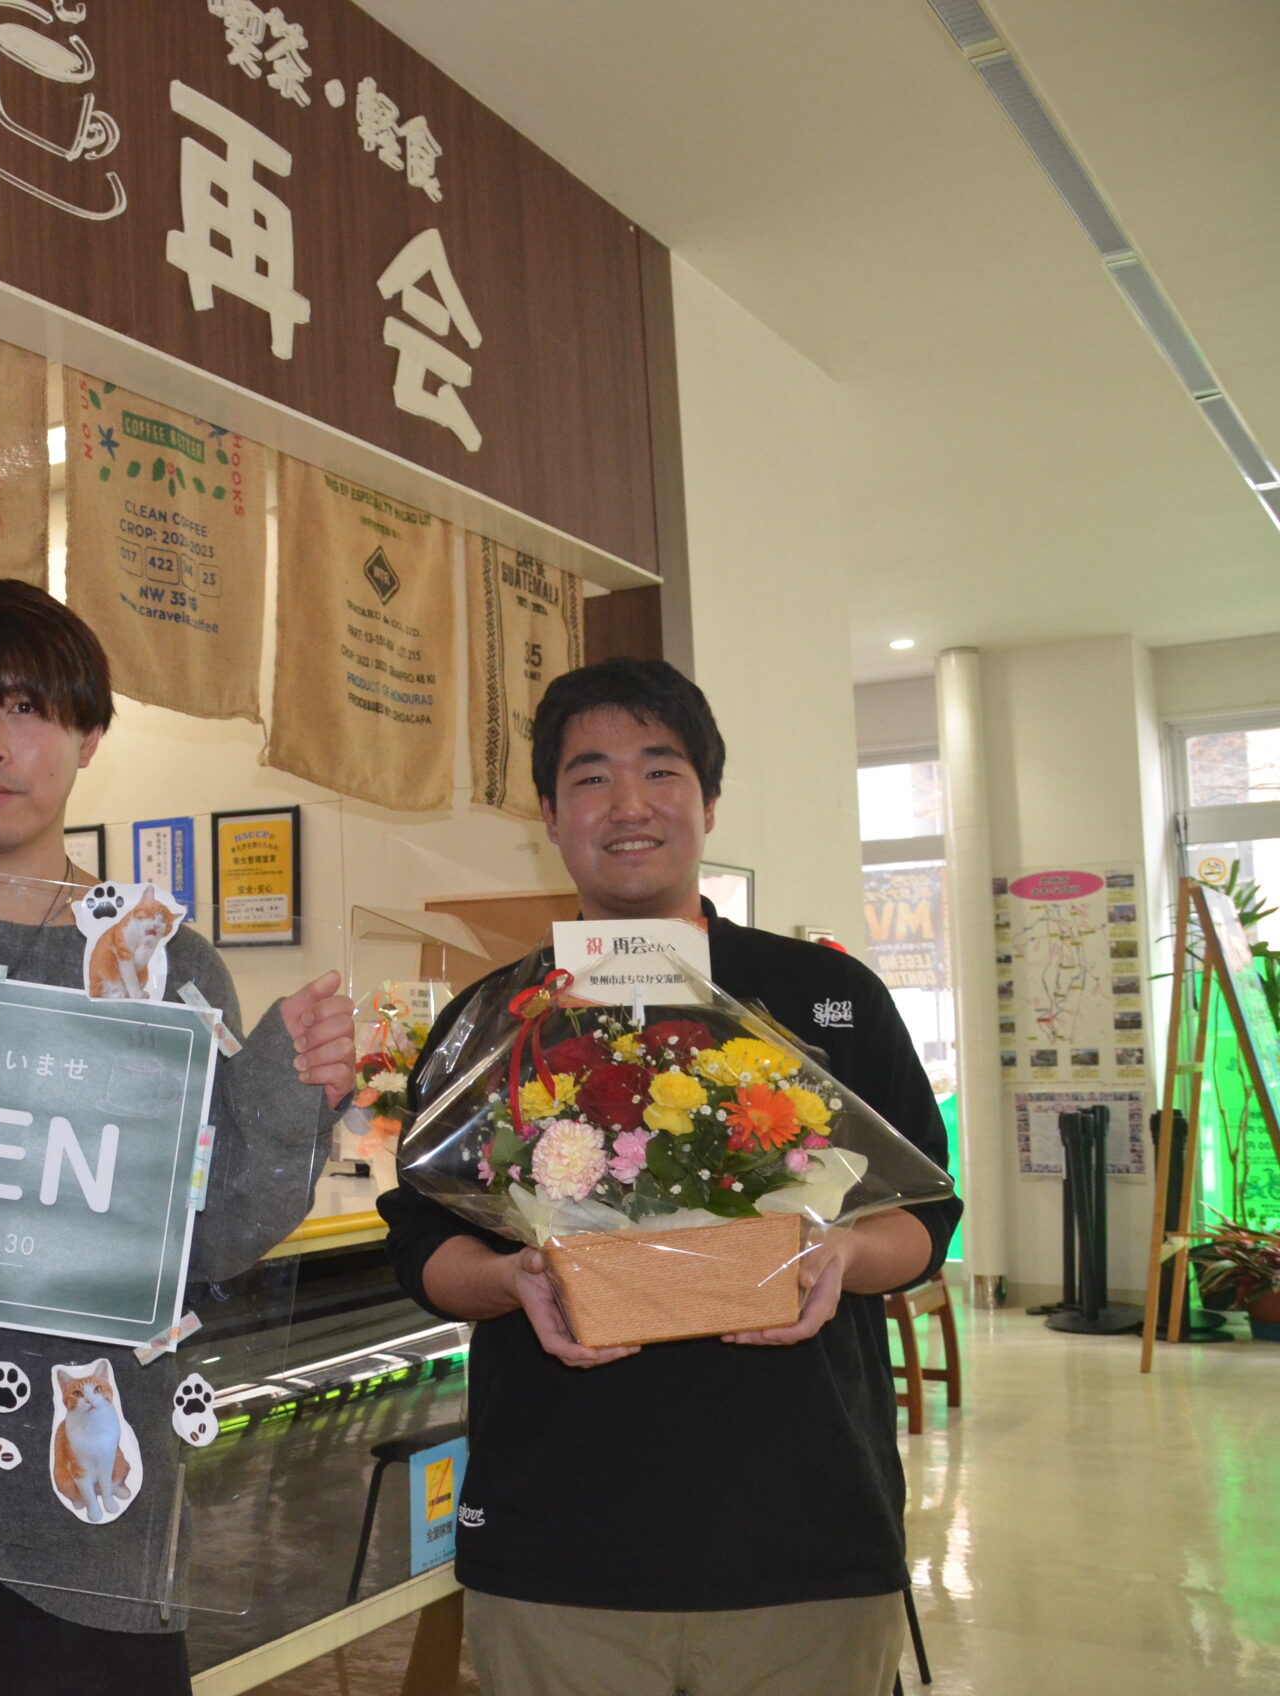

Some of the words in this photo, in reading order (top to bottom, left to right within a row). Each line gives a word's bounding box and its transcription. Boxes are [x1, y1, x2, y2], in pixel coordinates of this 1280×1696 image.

[166, 79, 483, 453] 再会
[125, 500, 168, 523] CLEAN
[119, 518, 158, 541] CROP:
[147, 556, 175, 572] 422
[202, 571, 217, 586] 23
[501, 561, 560, 608] GUATEMALA
[139, 585, 166, 604] NW
[585, 937, 603, 955] 祝
